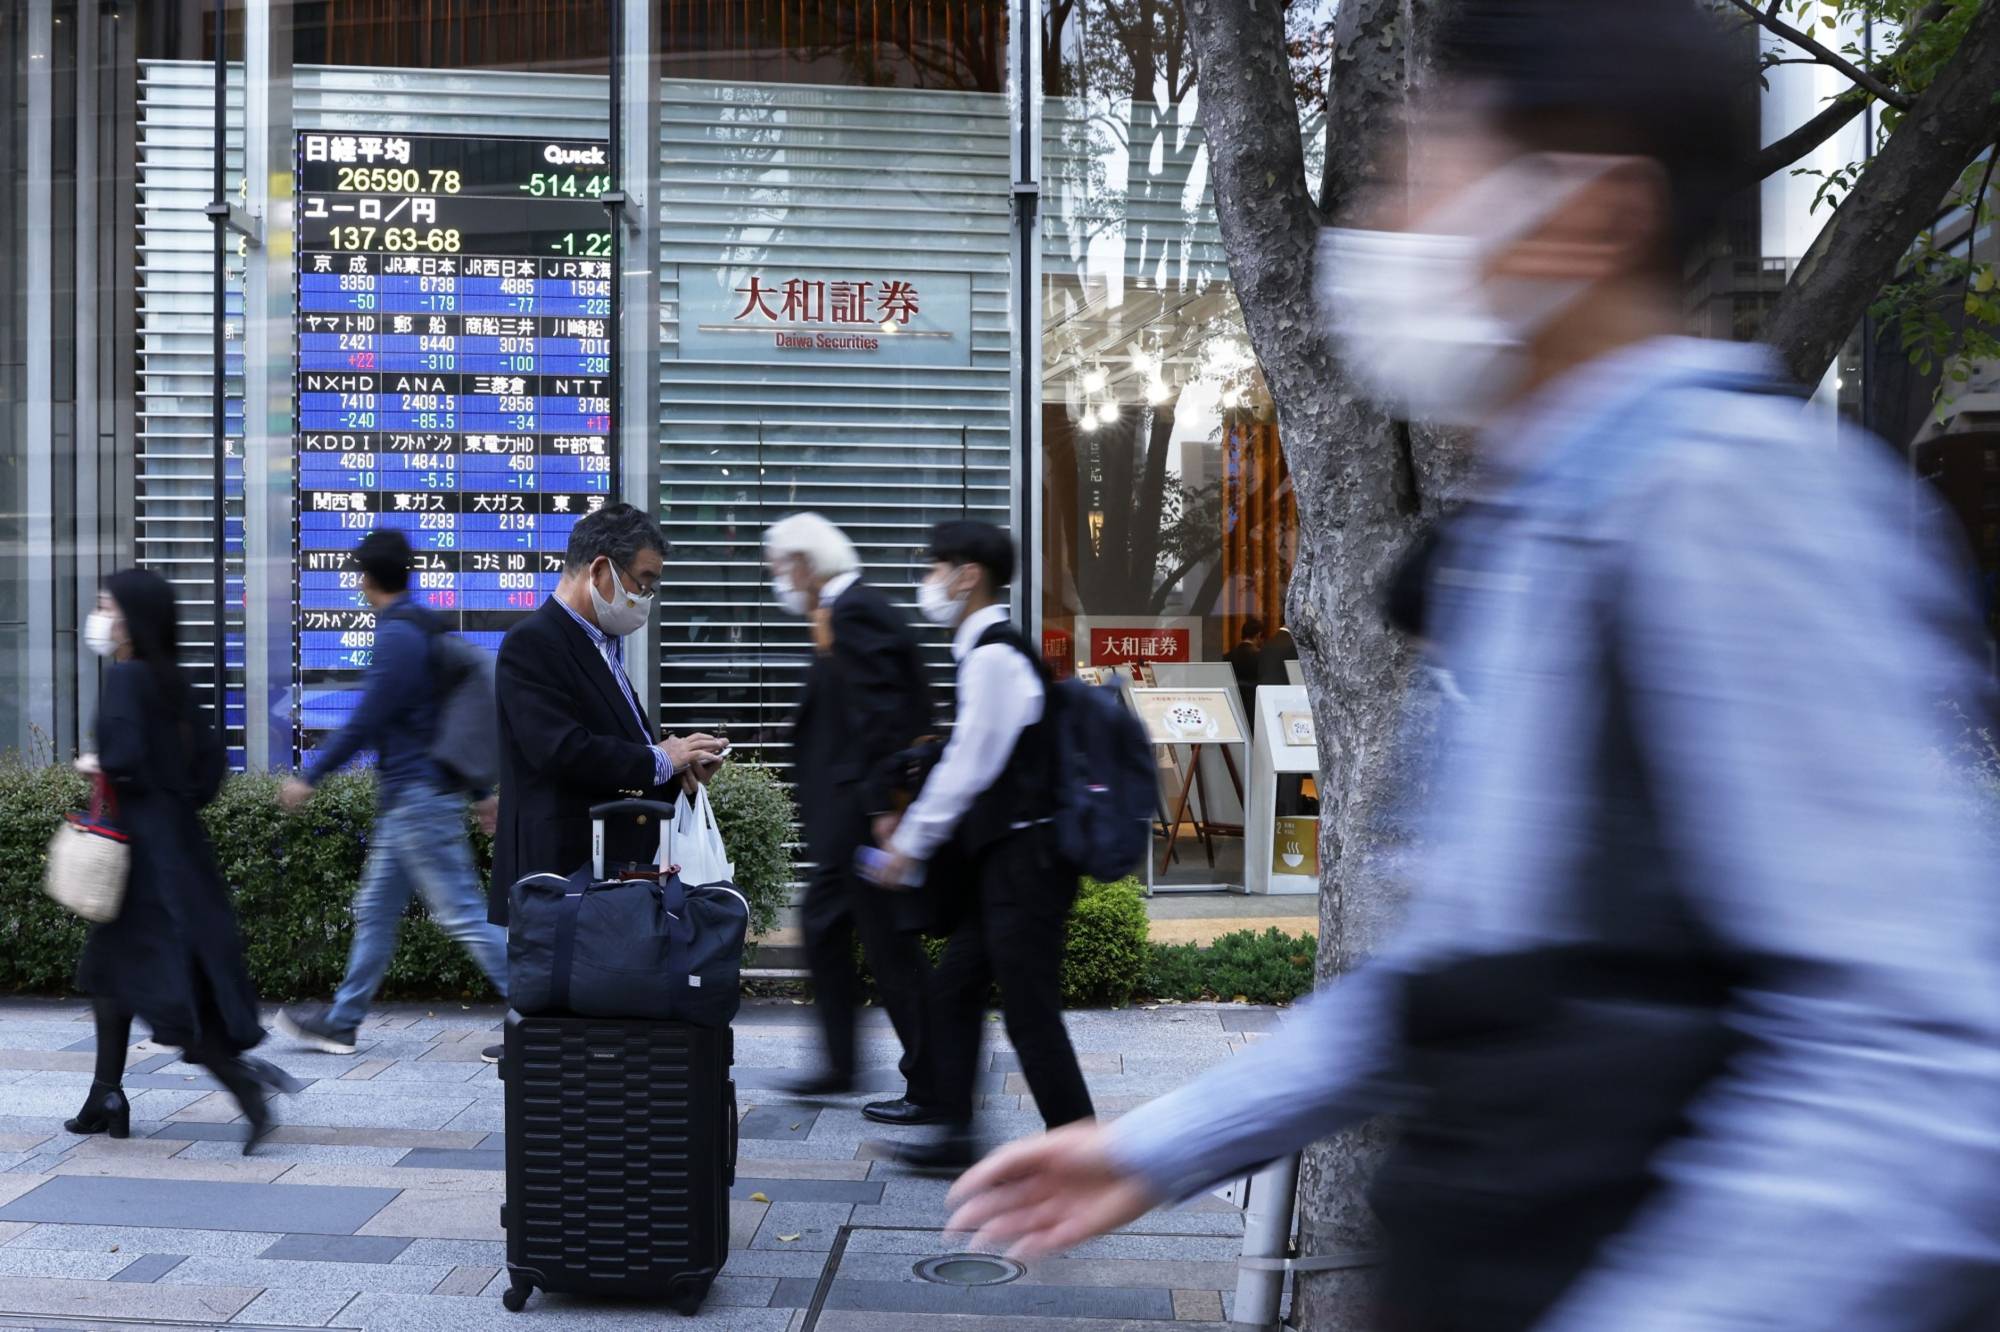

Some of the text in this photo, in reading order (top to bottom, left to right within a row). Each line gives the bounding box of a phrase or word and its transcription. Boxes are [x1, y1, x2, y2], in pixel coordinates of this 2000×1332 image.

[306, 136, 410, 164] 日経平均
[544, 145, 605, 165] Quick
[337, 168, 460, 193] 26590.78
[330, 227, 460, 252] 137.63-68
[384, 257, 456, 275] JR東日本
[465, 259, 535, 277] JR西日本
[420, 277, 454, 292] 6738
[500, 279, 534, 294] 4885
[349, 294, 375, 309] -50
[420, 295, 454, 310] -179
[509, 298, 533, 312] -77
[734, 277, 919, 325] 大和証券
[306, 315, 375, 332] ヤマトHD
[465, 318, 535, 336] 商船三井
[553, 319, 605, 338] 川崎船
[340, 335, 373, 350] 2421
[420, 335, 454, 351] 9440
[499, 338, 534, 353] 3075
[776, 333, 879, 350] Daiwa Securities
[348, 353, 374, 368] +22
[420, 355, 454, 370] -310
[500, 356, 534, 372] -100
[308, 376, 373, 391] NXHD
[396, 377, 446, 392] ANA
[474, 377, 526, 395] 三菱倉
[556, 380, 602, 395] NTT
[340, 394, 375, 410] 7410
[402, 395, 454, 411] 2409.5
[499, 397, 534, 412] 2956
[340, 413, 375, 428] -240
[411, 414, 454, 429] -85.5
[508, 415, 535, 430] -34
[307, 436, 369, 451] KDDI
[465, 435, 534, 453] 東電力HD
[554, 436, 605, 455] 中部電
[340, 454, 375, 469] 4260
[403, 454, 454, 470] 1484.0
[508, 455, 534, 470] 450
[349, 472, 375, 487] -10
[420, 473, 454, 488] -5.5
[508, 474, 535, 489] -14
[313, 493, 367, 511] 関西電
[394, 494, 446, 511] 東ガス
[473, 494, 525, 512] 大ガス
[341, 513, 375, 529] 1207
[420, 513, 454, 529] 2293
[499, 514, 535, 529] 2134
[429, 532, 454, 547] -26
[517, 533, 532, 548] -1
[420, 573, 454, 588] 8922
[499, 573, 534, 588] 8030
[429, 591, 455, 607] +13
[508, 591, 534, 607] +10
[1102, 636, 1178, 656] 大和証券
